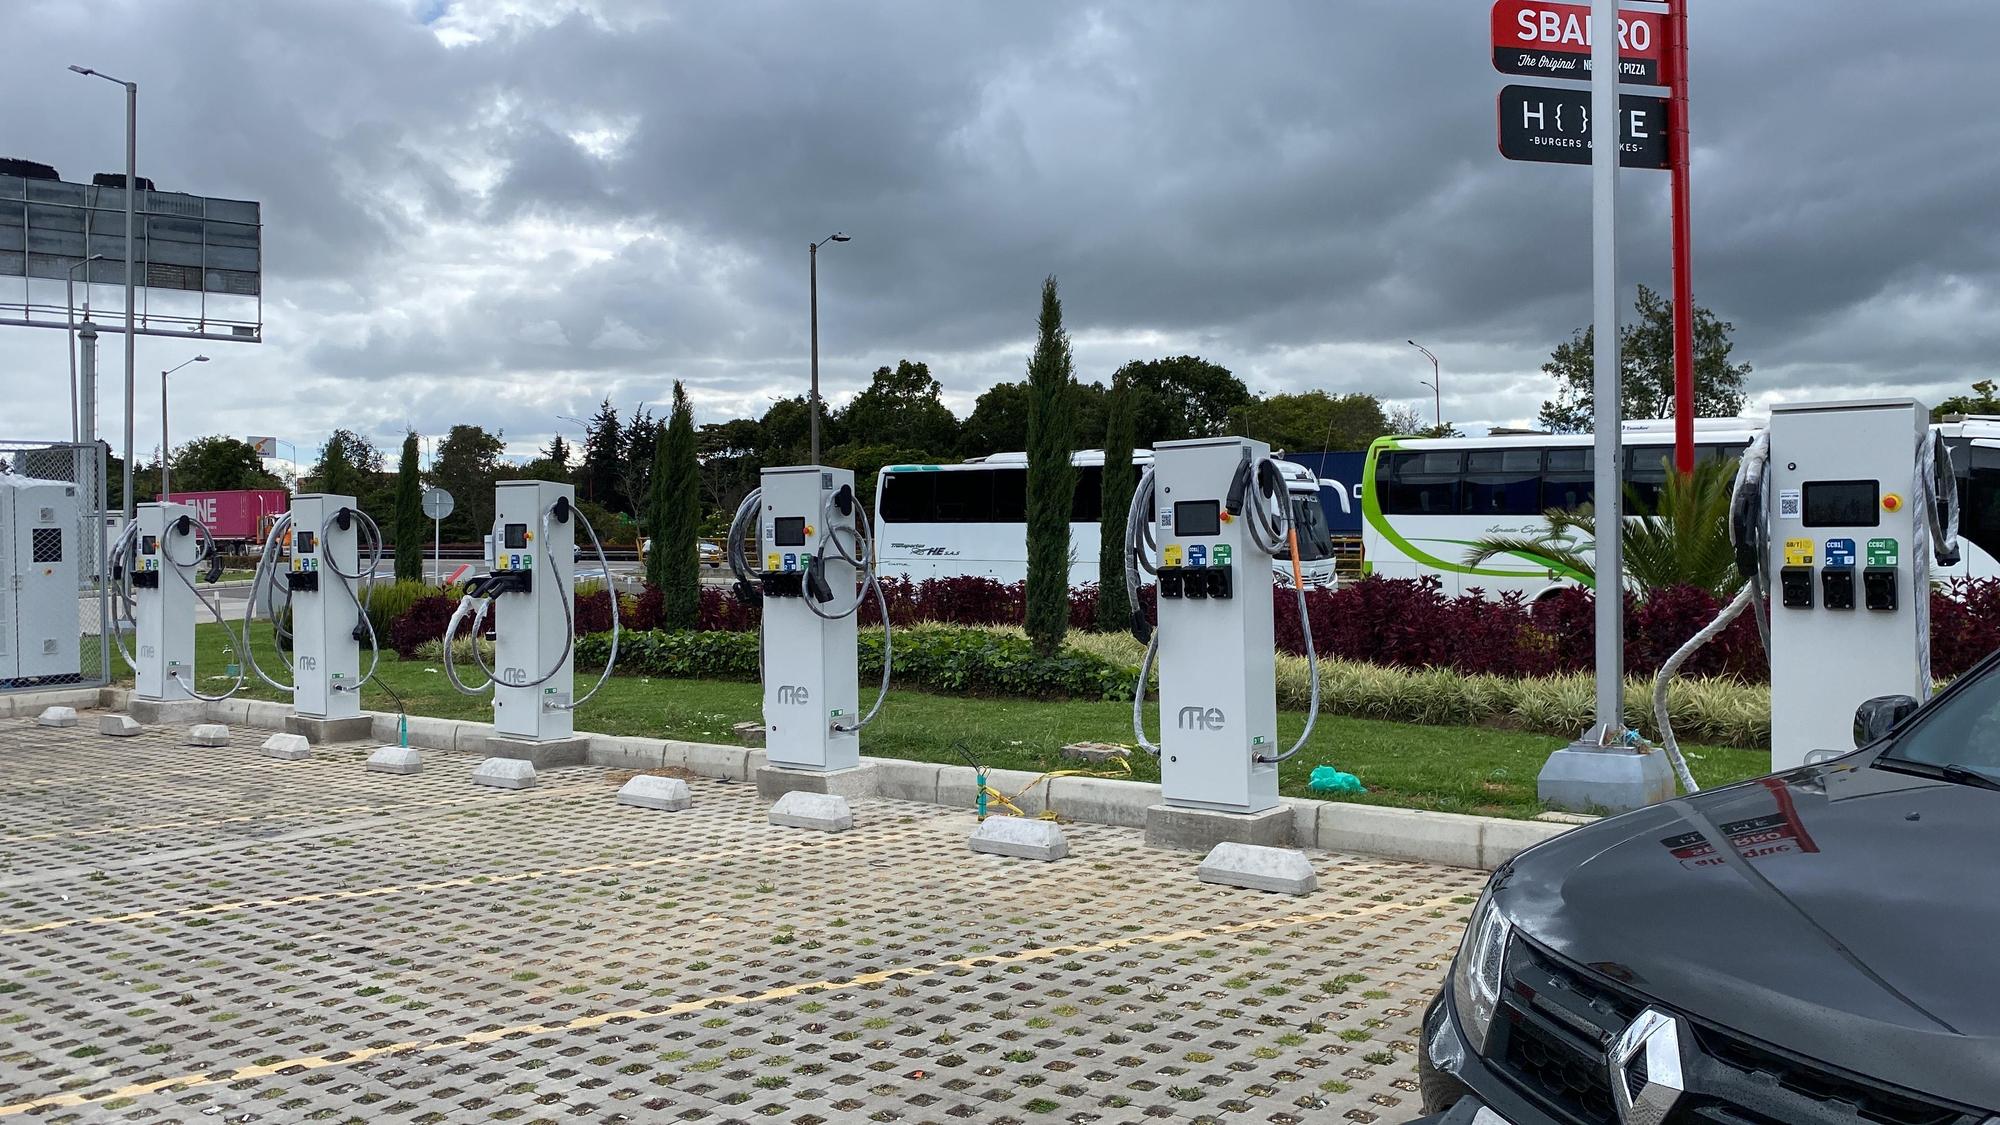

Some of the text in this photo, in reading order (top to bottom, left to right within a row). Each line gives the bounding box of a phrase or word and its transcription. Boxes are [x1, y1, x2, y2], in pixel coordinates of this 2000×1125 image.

[1517, 9, 1651, 51] SBARO
[1517, 54, 1536, 67] The
[1538, 55, 1576, 72] Original
[1623, 63, 1646, 76] PIZZA
[1826, 557, 1833, 565] 2
[1868, 557, 1875, 565] 3
